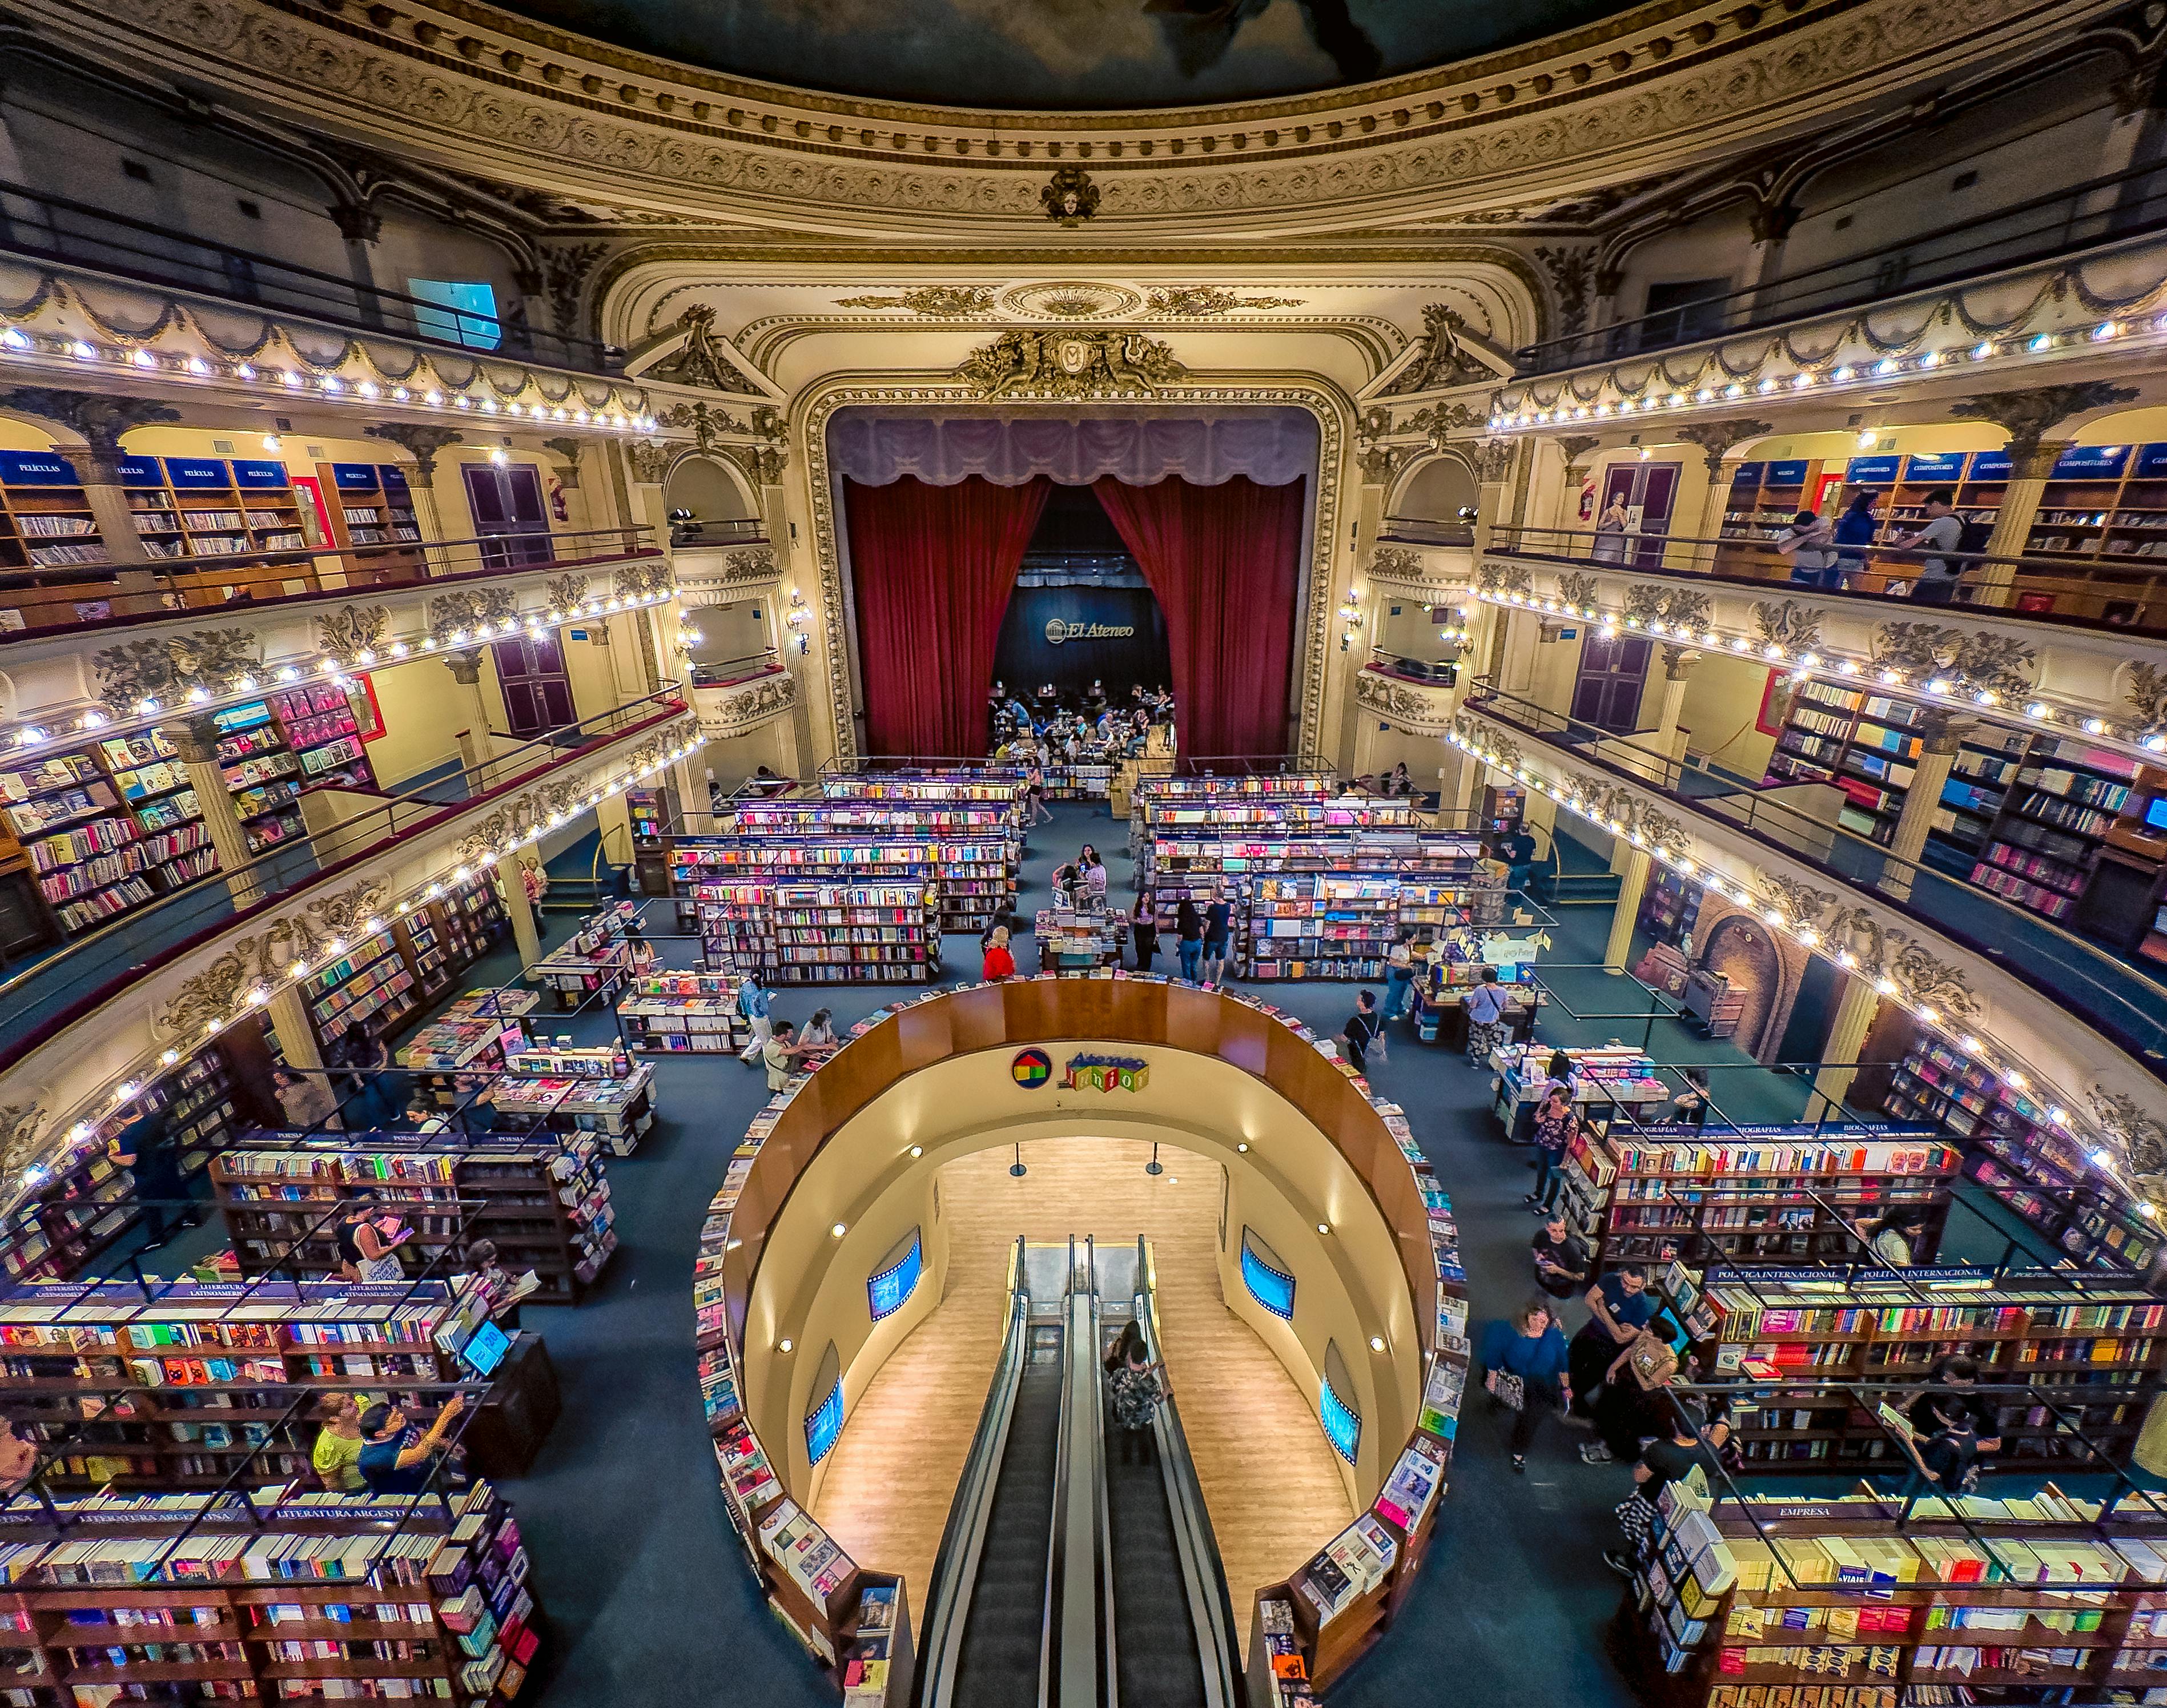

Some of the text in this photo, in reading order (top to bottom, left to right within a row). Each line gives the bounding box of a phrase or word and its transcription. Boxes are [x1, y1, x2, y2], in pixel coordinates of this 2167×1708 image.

[116, 466, 144, 475] LÍCULAS
[1066, 622, 1134, 638] El Ateneo
[1907, 1268, 1984, 1277] INTERNACIONAL
[1779, 1507, 1830, 1516] EMPRESA
